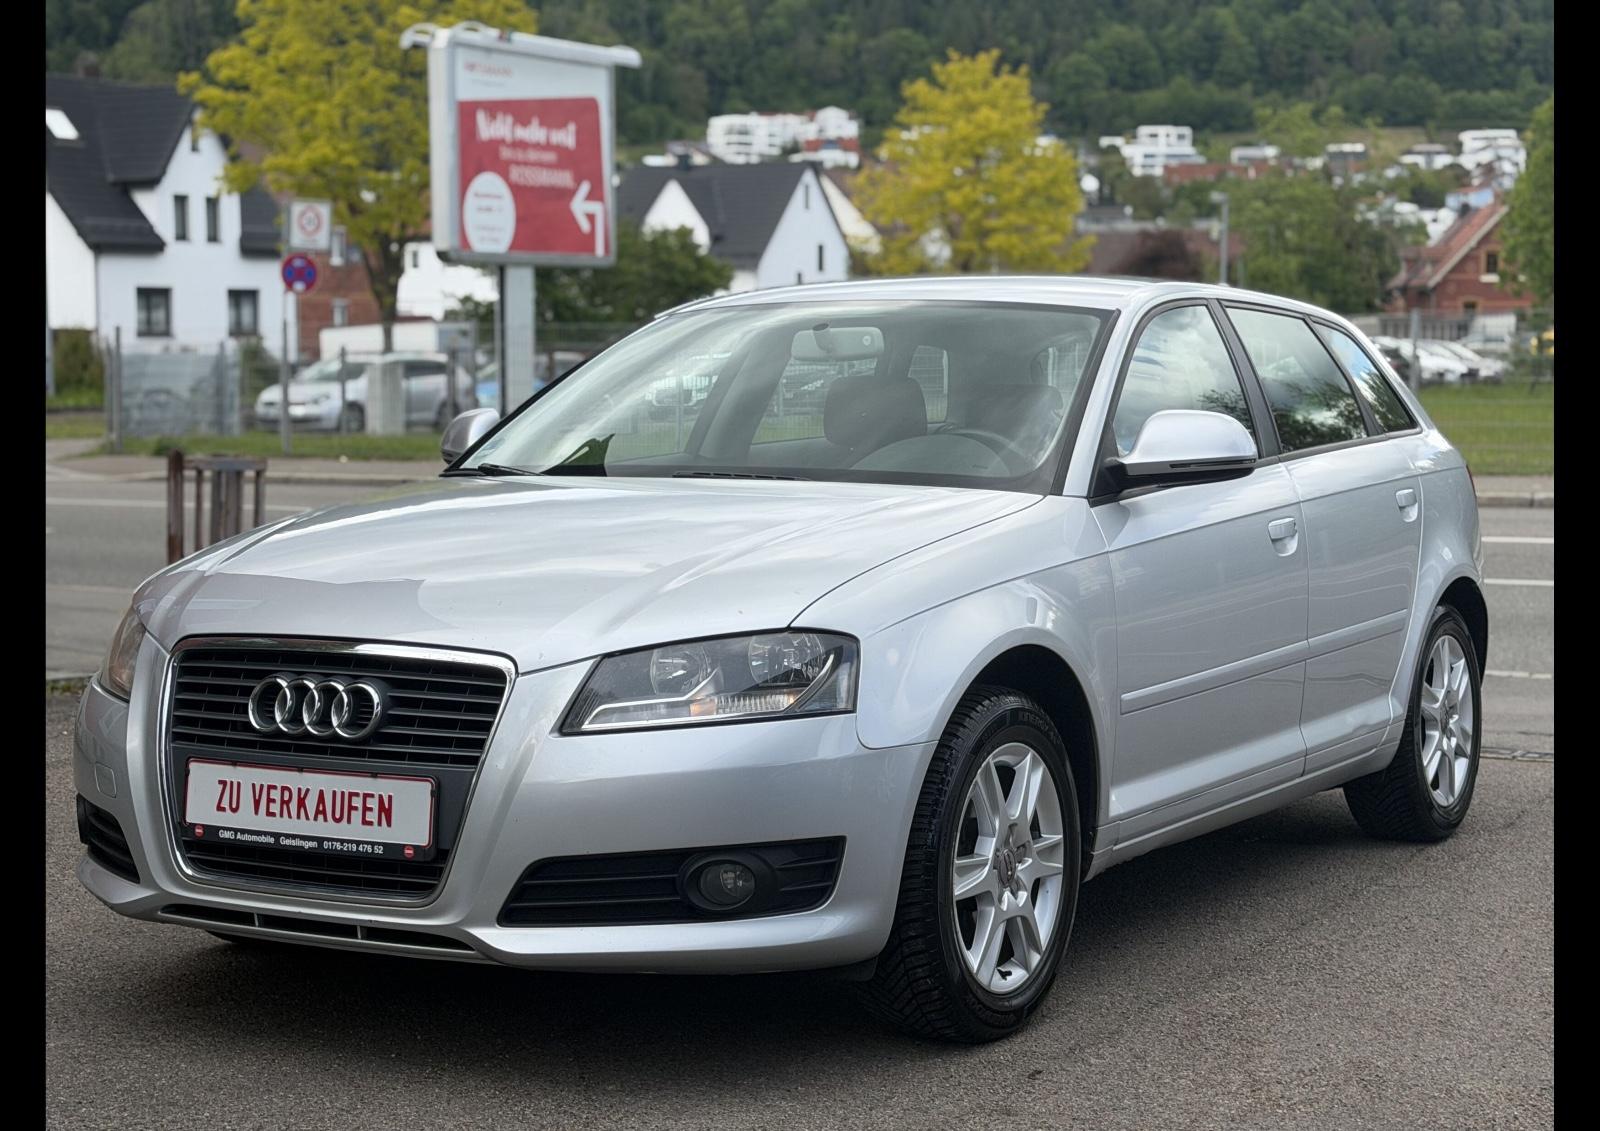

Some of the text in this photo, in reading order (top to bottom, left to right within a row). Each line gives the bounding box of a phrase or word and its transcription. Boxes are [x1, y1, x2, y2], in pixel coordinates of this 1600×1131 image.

[216, 780, 393, 828] ZU VERKAUFEN
[219, 829, 384, 854] GMG Automobile Geislingen 0176-219 476 52
